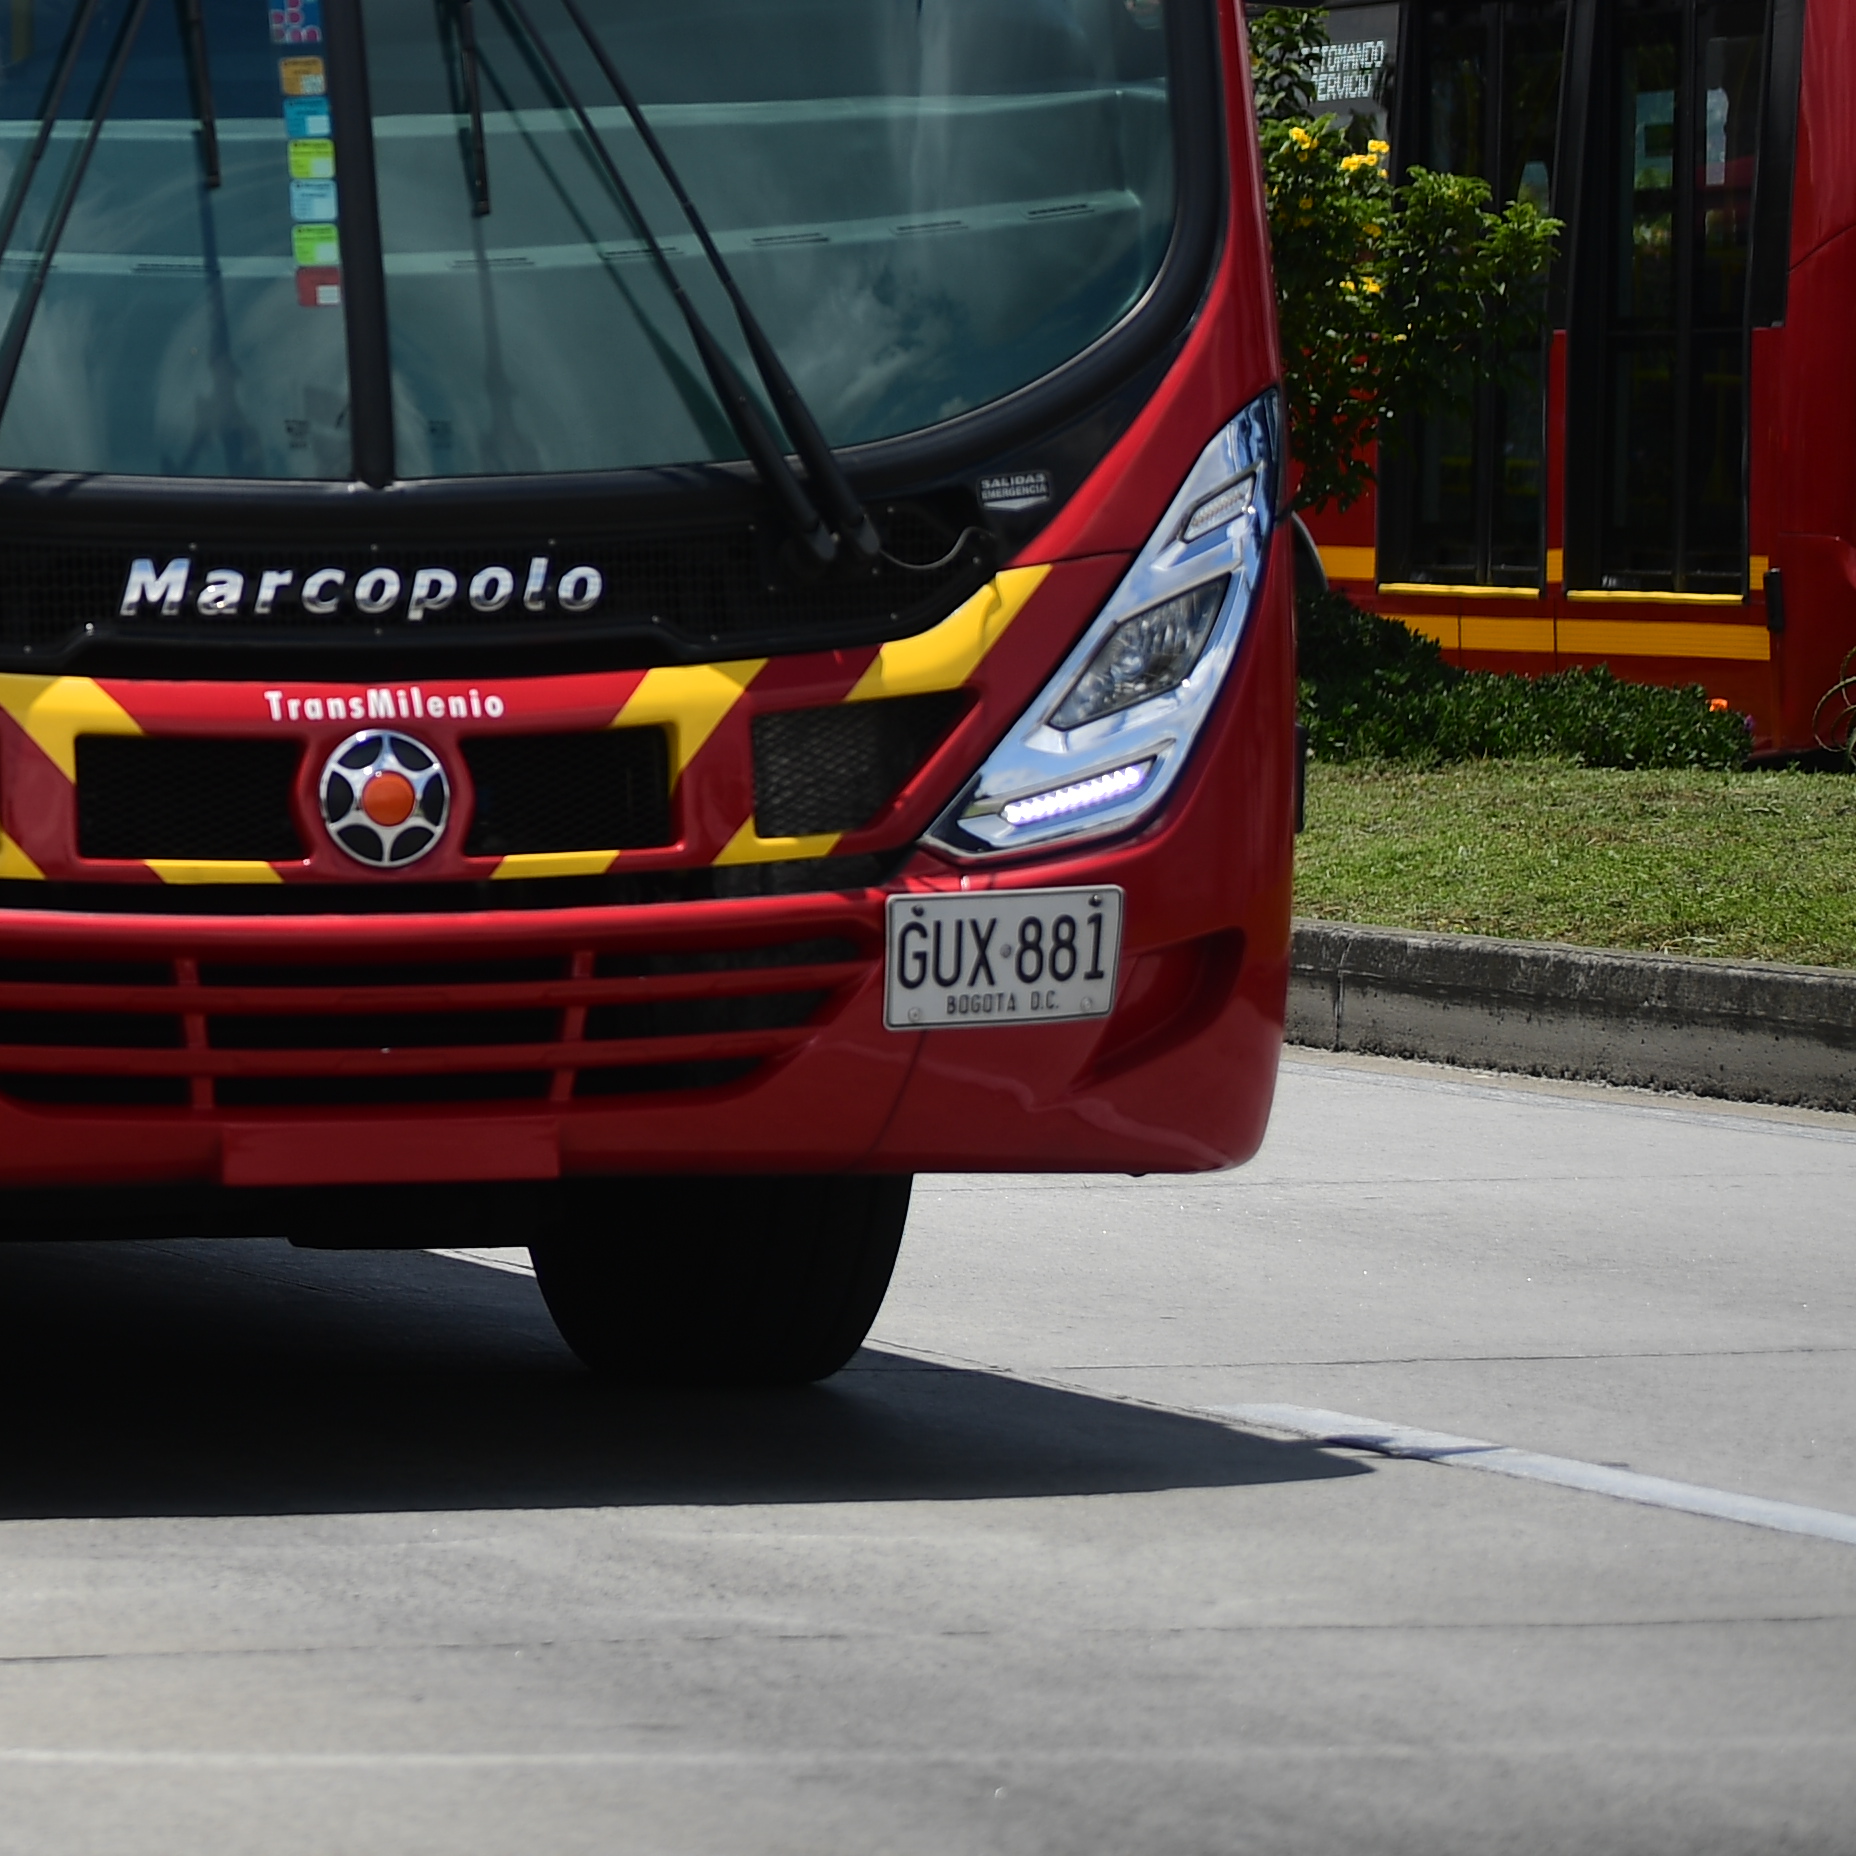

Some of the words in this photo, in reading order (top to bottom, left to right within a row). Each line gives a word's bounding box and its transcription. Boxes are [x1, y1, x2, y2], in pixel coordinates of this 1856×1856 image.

[980, 472, 1046, 490] SALIDAS
[119, 556, 604, 622] Marcopolo
[263, 686, 505, 722] TransMilenio
[897, 916, 998, 990] GUX
[1015, 912, 1105, 985] 881
[946, 992, 1017, 1016] BOGOTA
[1029, 989, 1060, 1011] D.C.
